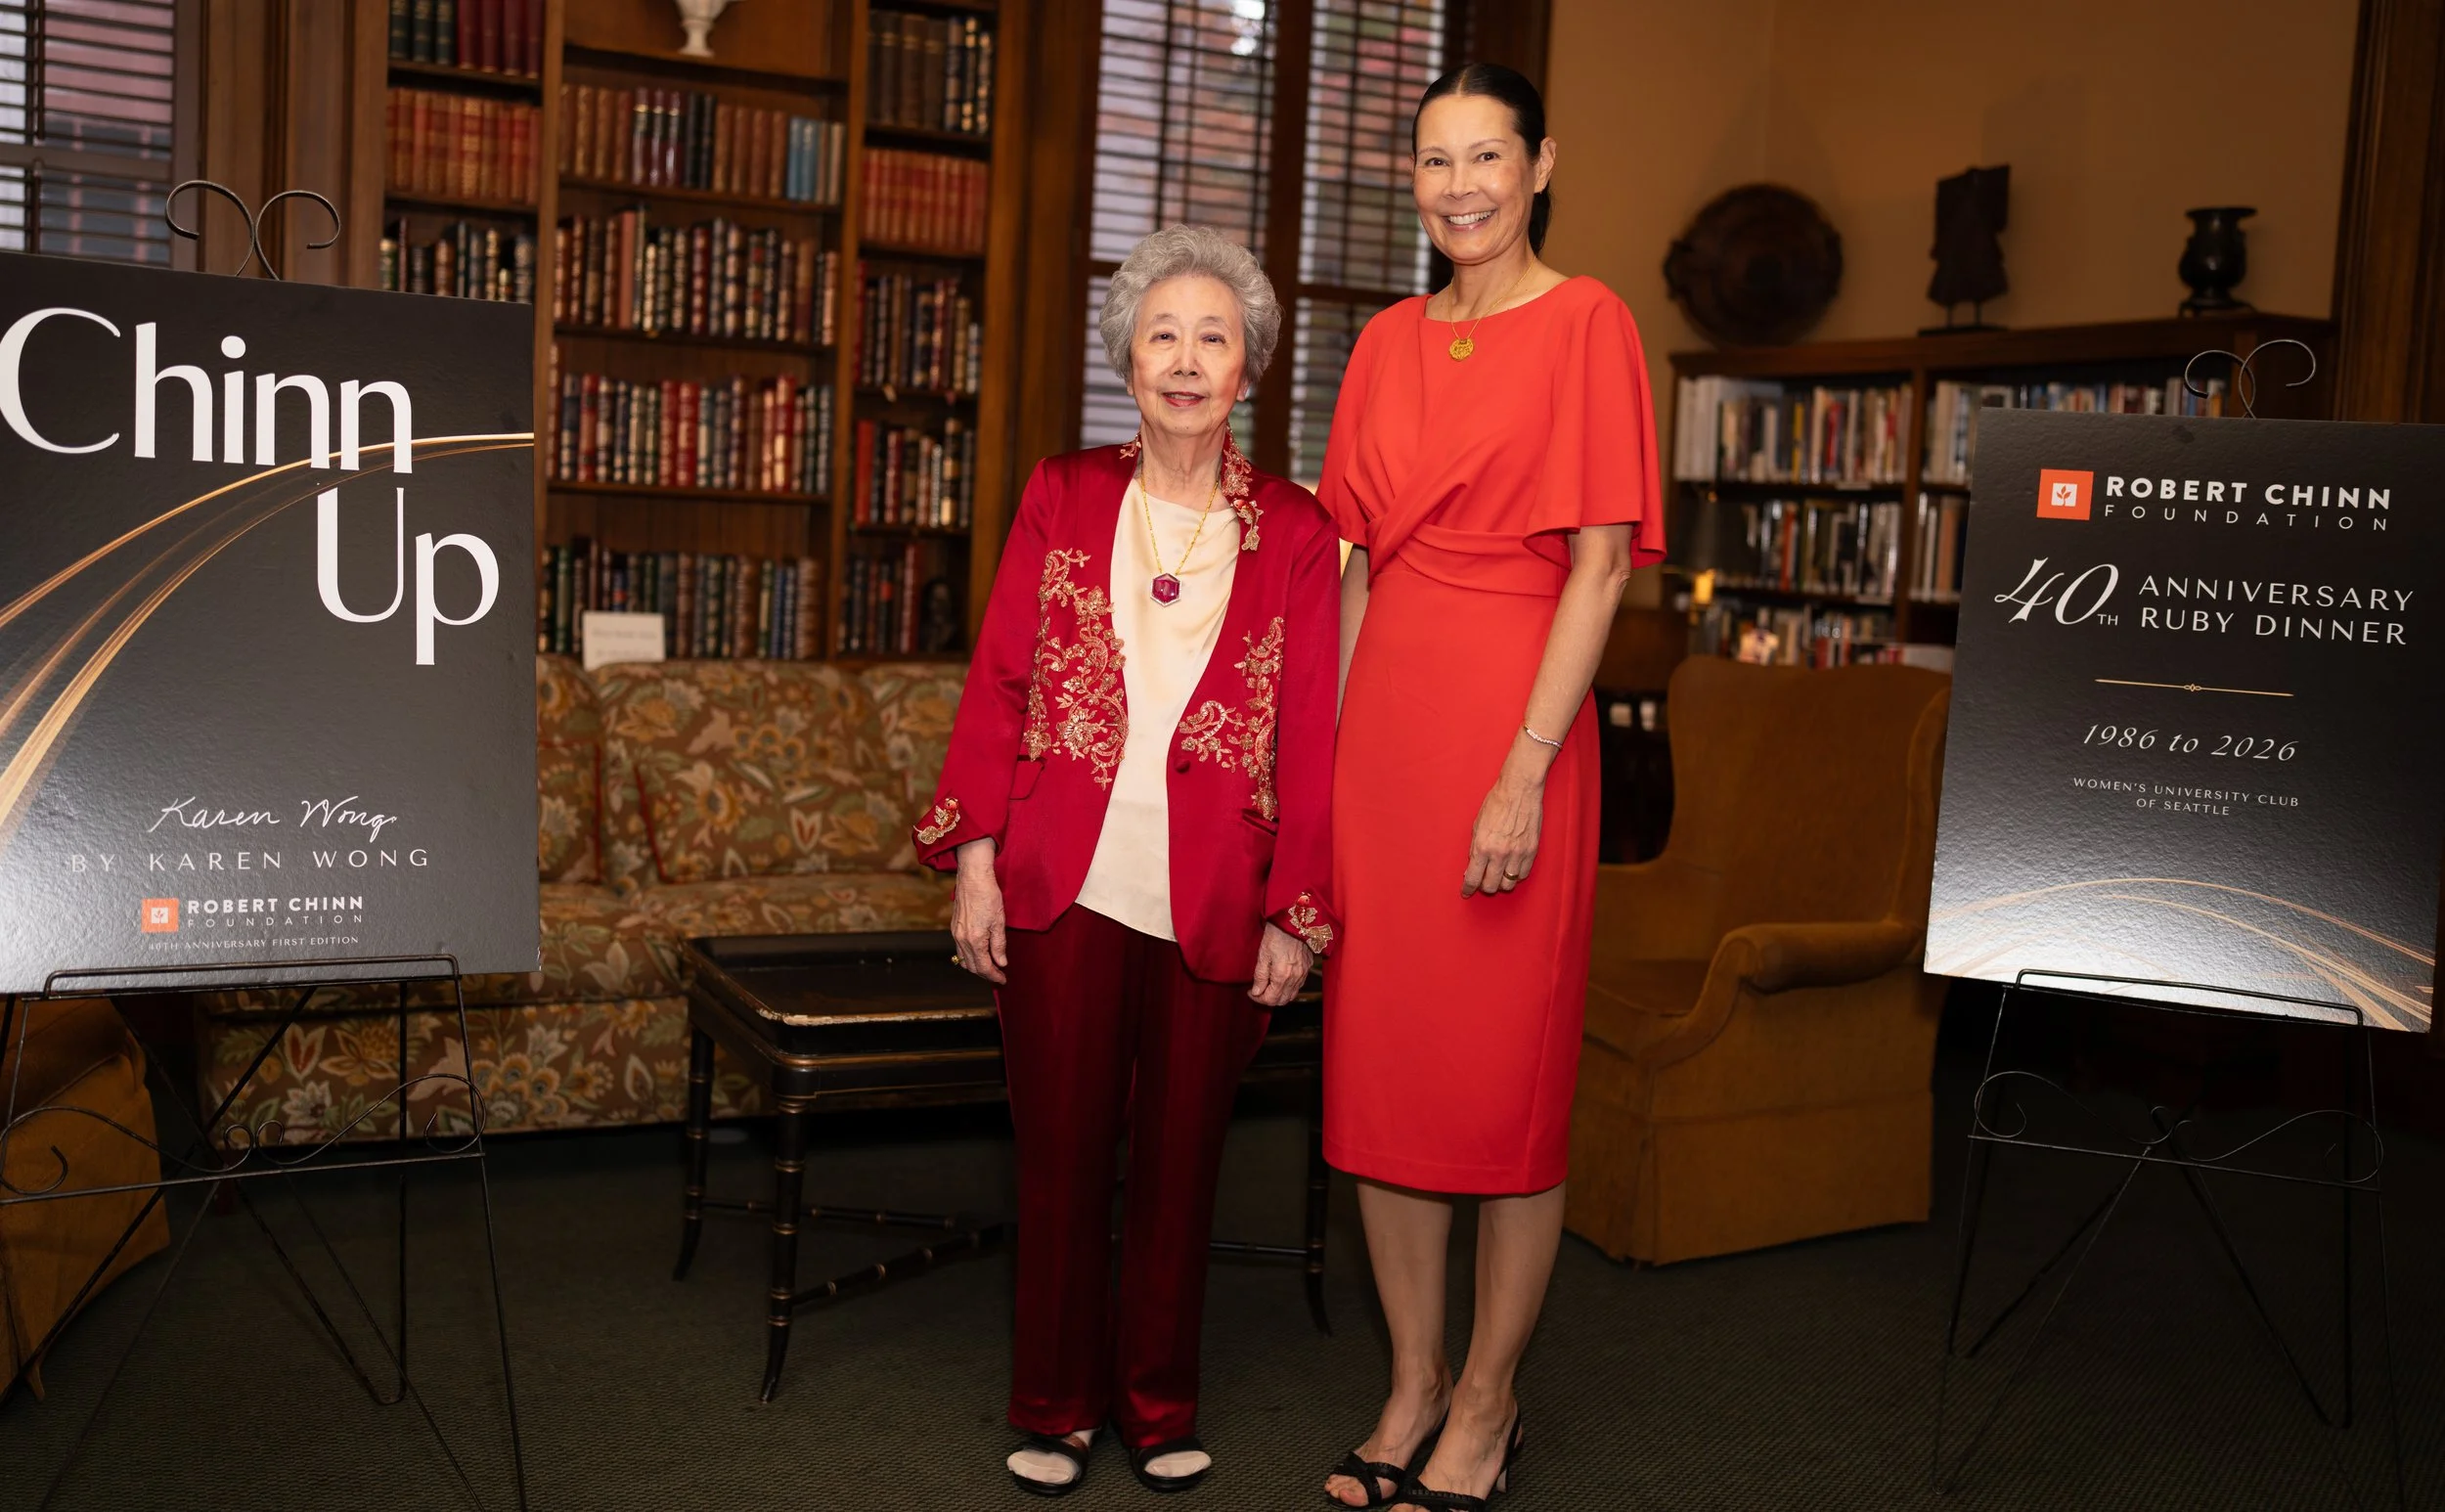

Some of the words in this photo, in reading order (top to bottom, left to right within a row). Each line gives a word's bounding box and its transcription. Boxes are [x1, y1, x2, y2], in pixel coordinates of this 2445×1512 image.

[0, 307, 413, 474] Chinn
[2106, 475, 2247, 503] ROBERT
[2264, 484, 2390, 511] CHINN
[2105, 504, 2387, 531] FOUNDATION
[317, 487, 500, 666] Up
[2138, 575, 2415, 612] ANNIVERSARY
[2141, 606, 2235, 634] RUBY
[2255, 614, 2407, 645] DINNER
[2083, 723, 2158, 750] 1986
[2168, 733, 2200, 754] to
[2210, 734, 2299, 762] 2026
[2073, 777, 2147, 794] WOMEN'S
[2155, 784, 2250, 803] UNIVERSITY
[2257, 793, 2299, 808] CLUB
[2136, 798, 2156, 809] OF
[2163, 800, 2230, 816] SEATTLE
[147, 795, 281, 833] Karen
[300, 795, 398, 843] Wong
[70, 852, 116, 873] BY
[149, 851, 282, 872] KAREN
[312, 848, 429, 868] WONG
[188, 898, 278, 914] ROBERT
[289, 896, 363, 912] CHINN
[188, 914, 362, 928] FOUNDATION
[184, 940, 266, 951] ANNIVERSARY
[272, 938, 305, 947] FIRST
[311, 936, 359, 946] EDITION
